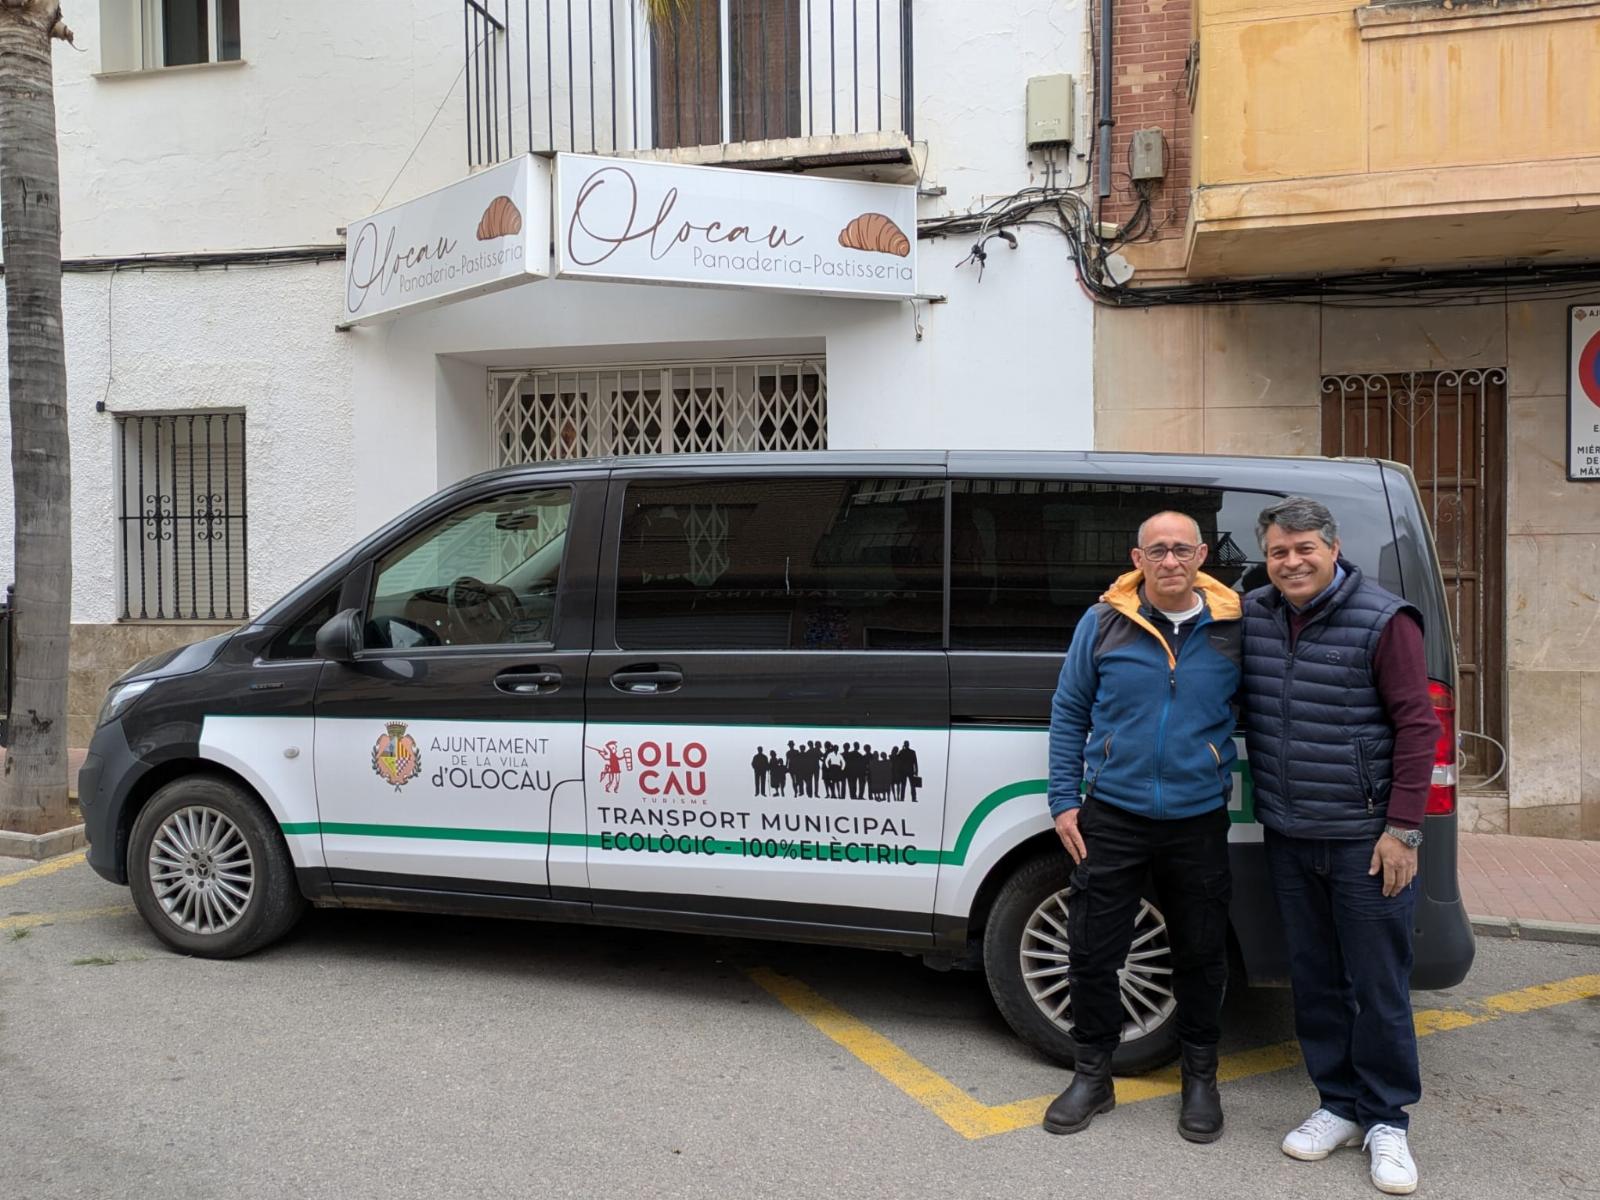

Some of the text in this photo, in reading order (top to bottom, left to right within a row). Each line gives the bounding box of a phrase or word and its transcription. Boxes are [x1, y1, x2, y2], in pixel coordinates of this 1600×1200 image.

[567, 166, 805, 266] Olocau
[347, 222, 458, 314] Olocau
[693, 246, 914, 282] Panaderia-Pastisseria
[430, 736, 550, 755] AJUNTAMENT
[637, 740, 708, 769] OLO
[451, 754, 529, 768] DE LA VILA
[431, 766, 552, 791] d'OLOCAU
[638, 769, 707, 796] CAU
[642, 796, 709, 805] TURISME
[597, 806, 916, 837] TRANSPORT MUNICIPAL
[600, 828, 716, 856] ECOLÒGIC
